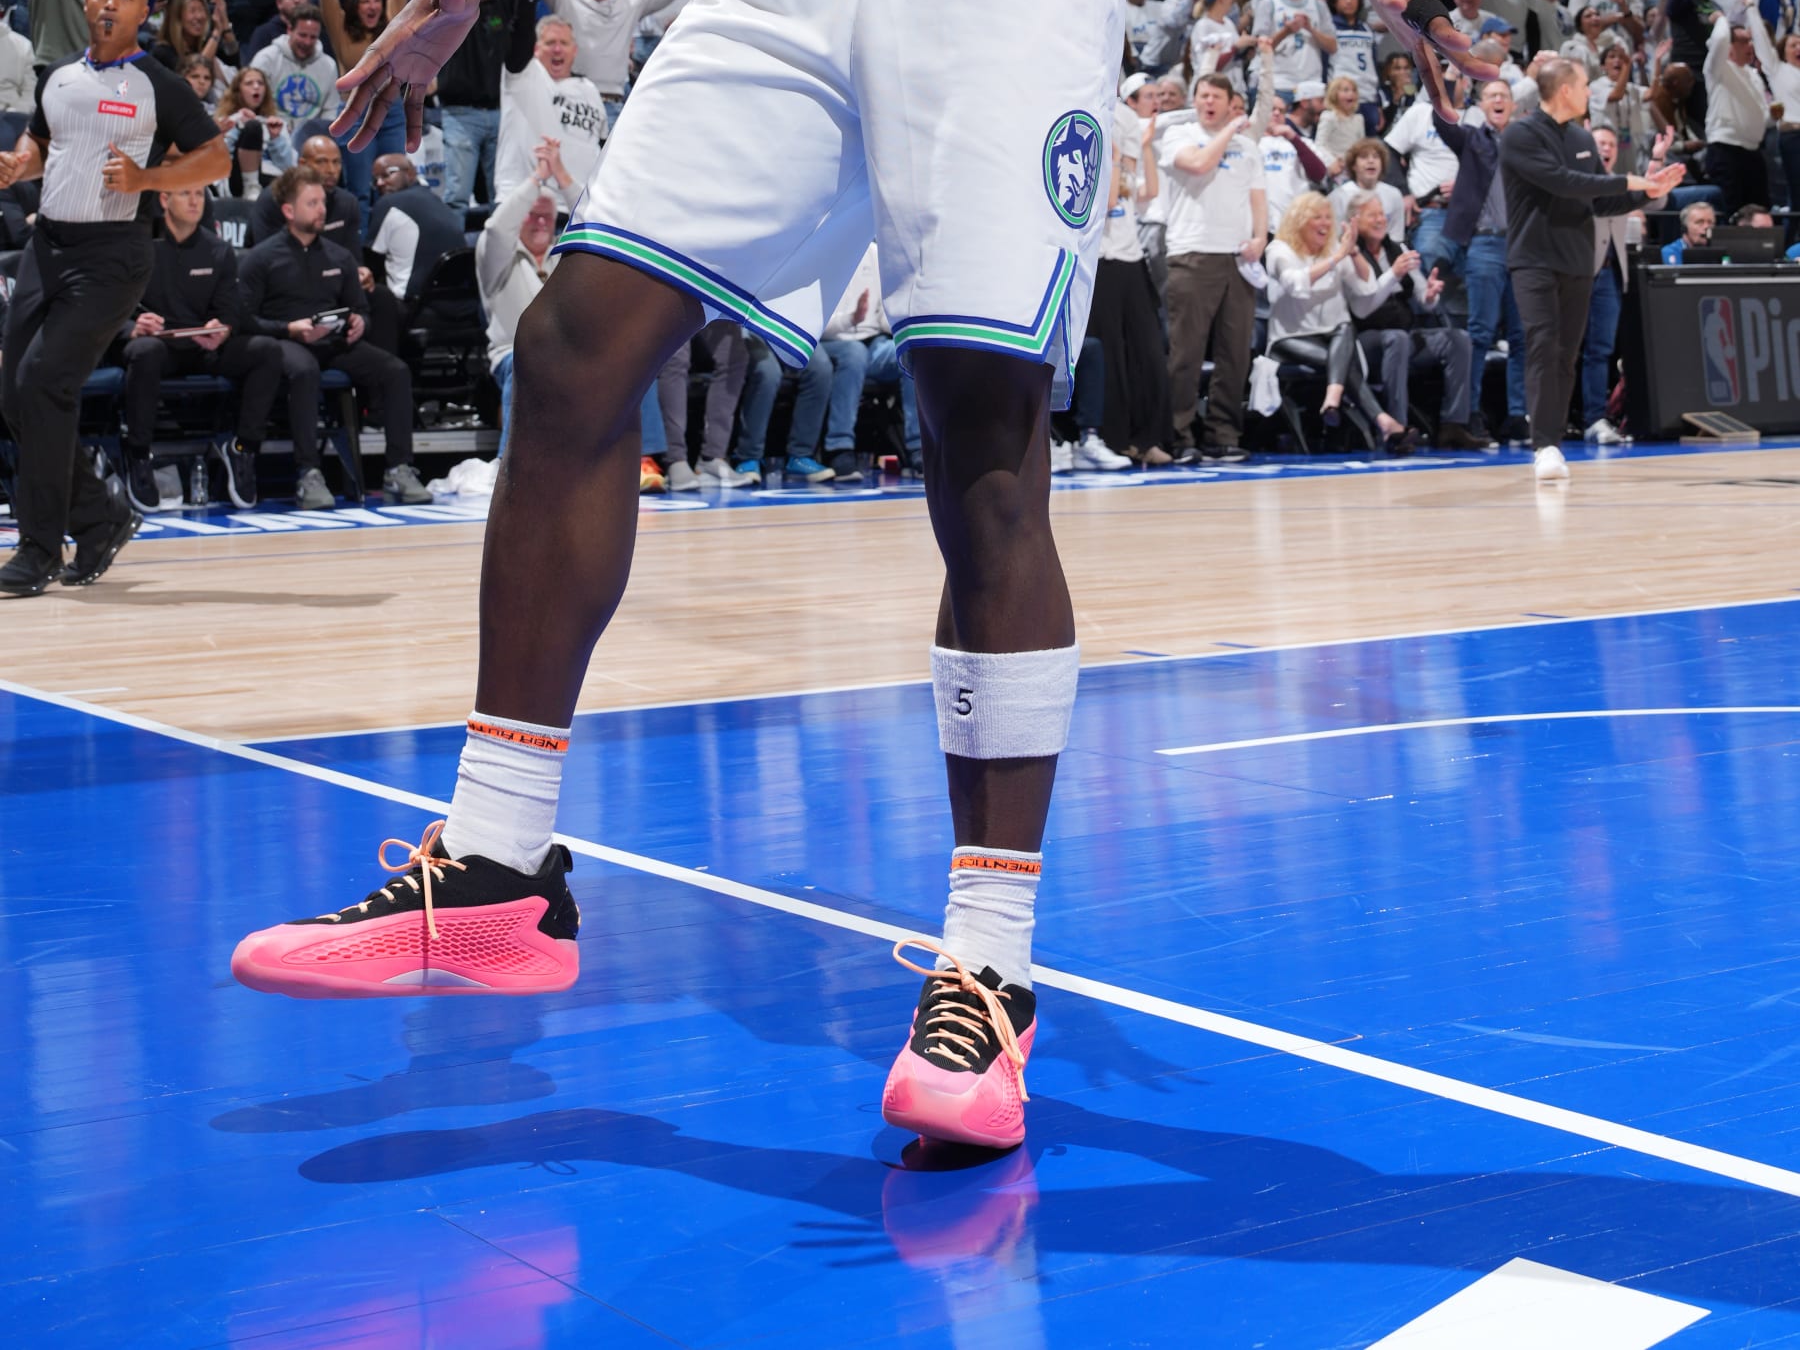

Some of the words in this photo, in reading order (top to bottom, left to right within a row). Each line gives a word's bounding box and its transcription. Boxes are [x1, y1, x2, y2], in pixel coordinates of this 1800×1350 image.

[1356, 52, 1367, 71] 5
[101, 102, 134, 116] Emirates
[955, 688, 974, 716] 5
